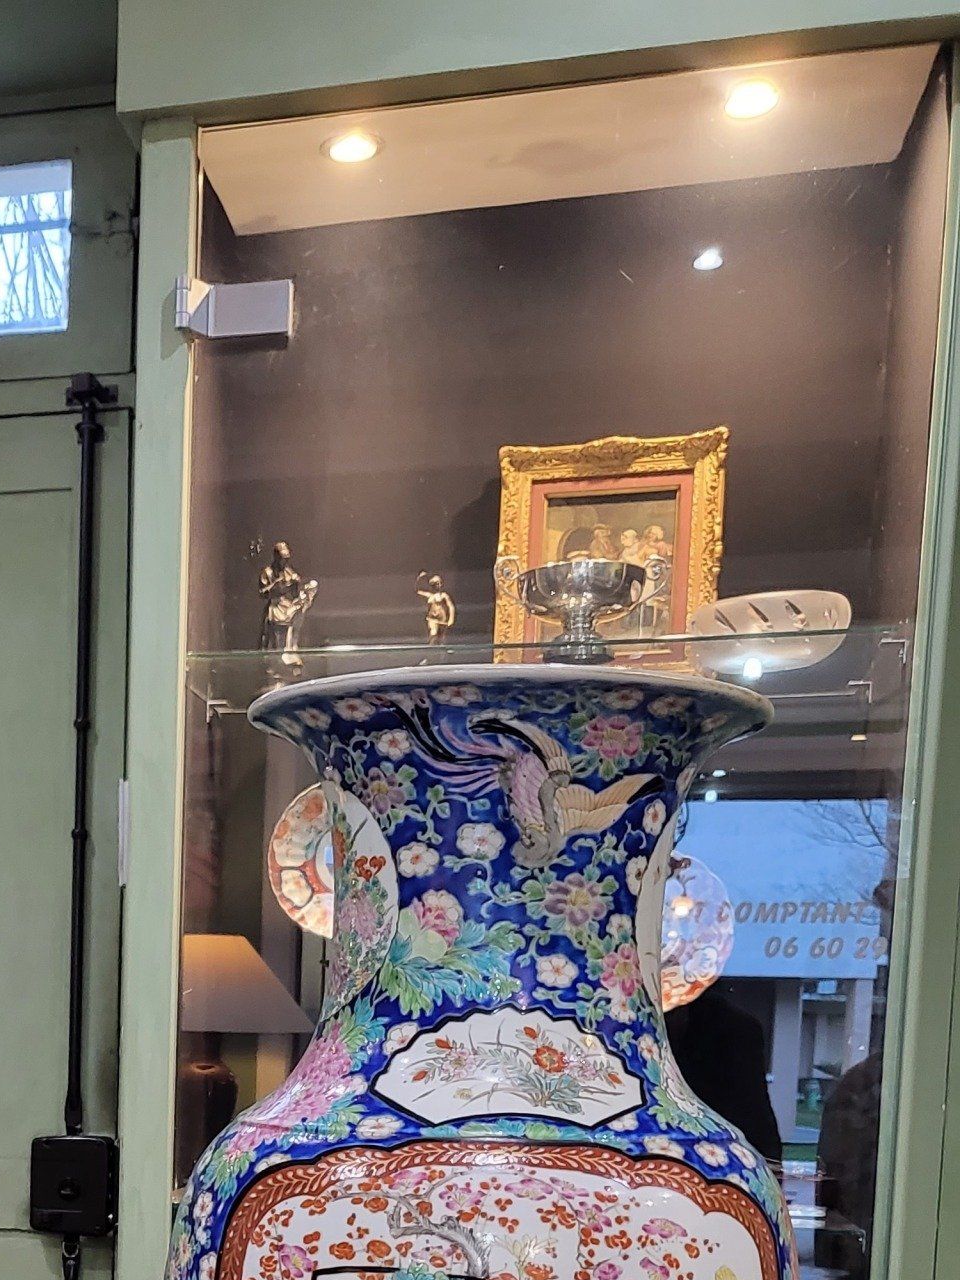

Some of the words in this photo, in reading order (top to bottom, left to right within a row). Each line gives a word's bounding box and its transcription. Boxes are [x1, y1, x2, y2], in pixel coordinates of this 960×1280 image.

[717, 901, 870, 923] COMPTANT
[764, 937, 798, 958] 06
[809, 937, 844, 958] 60
